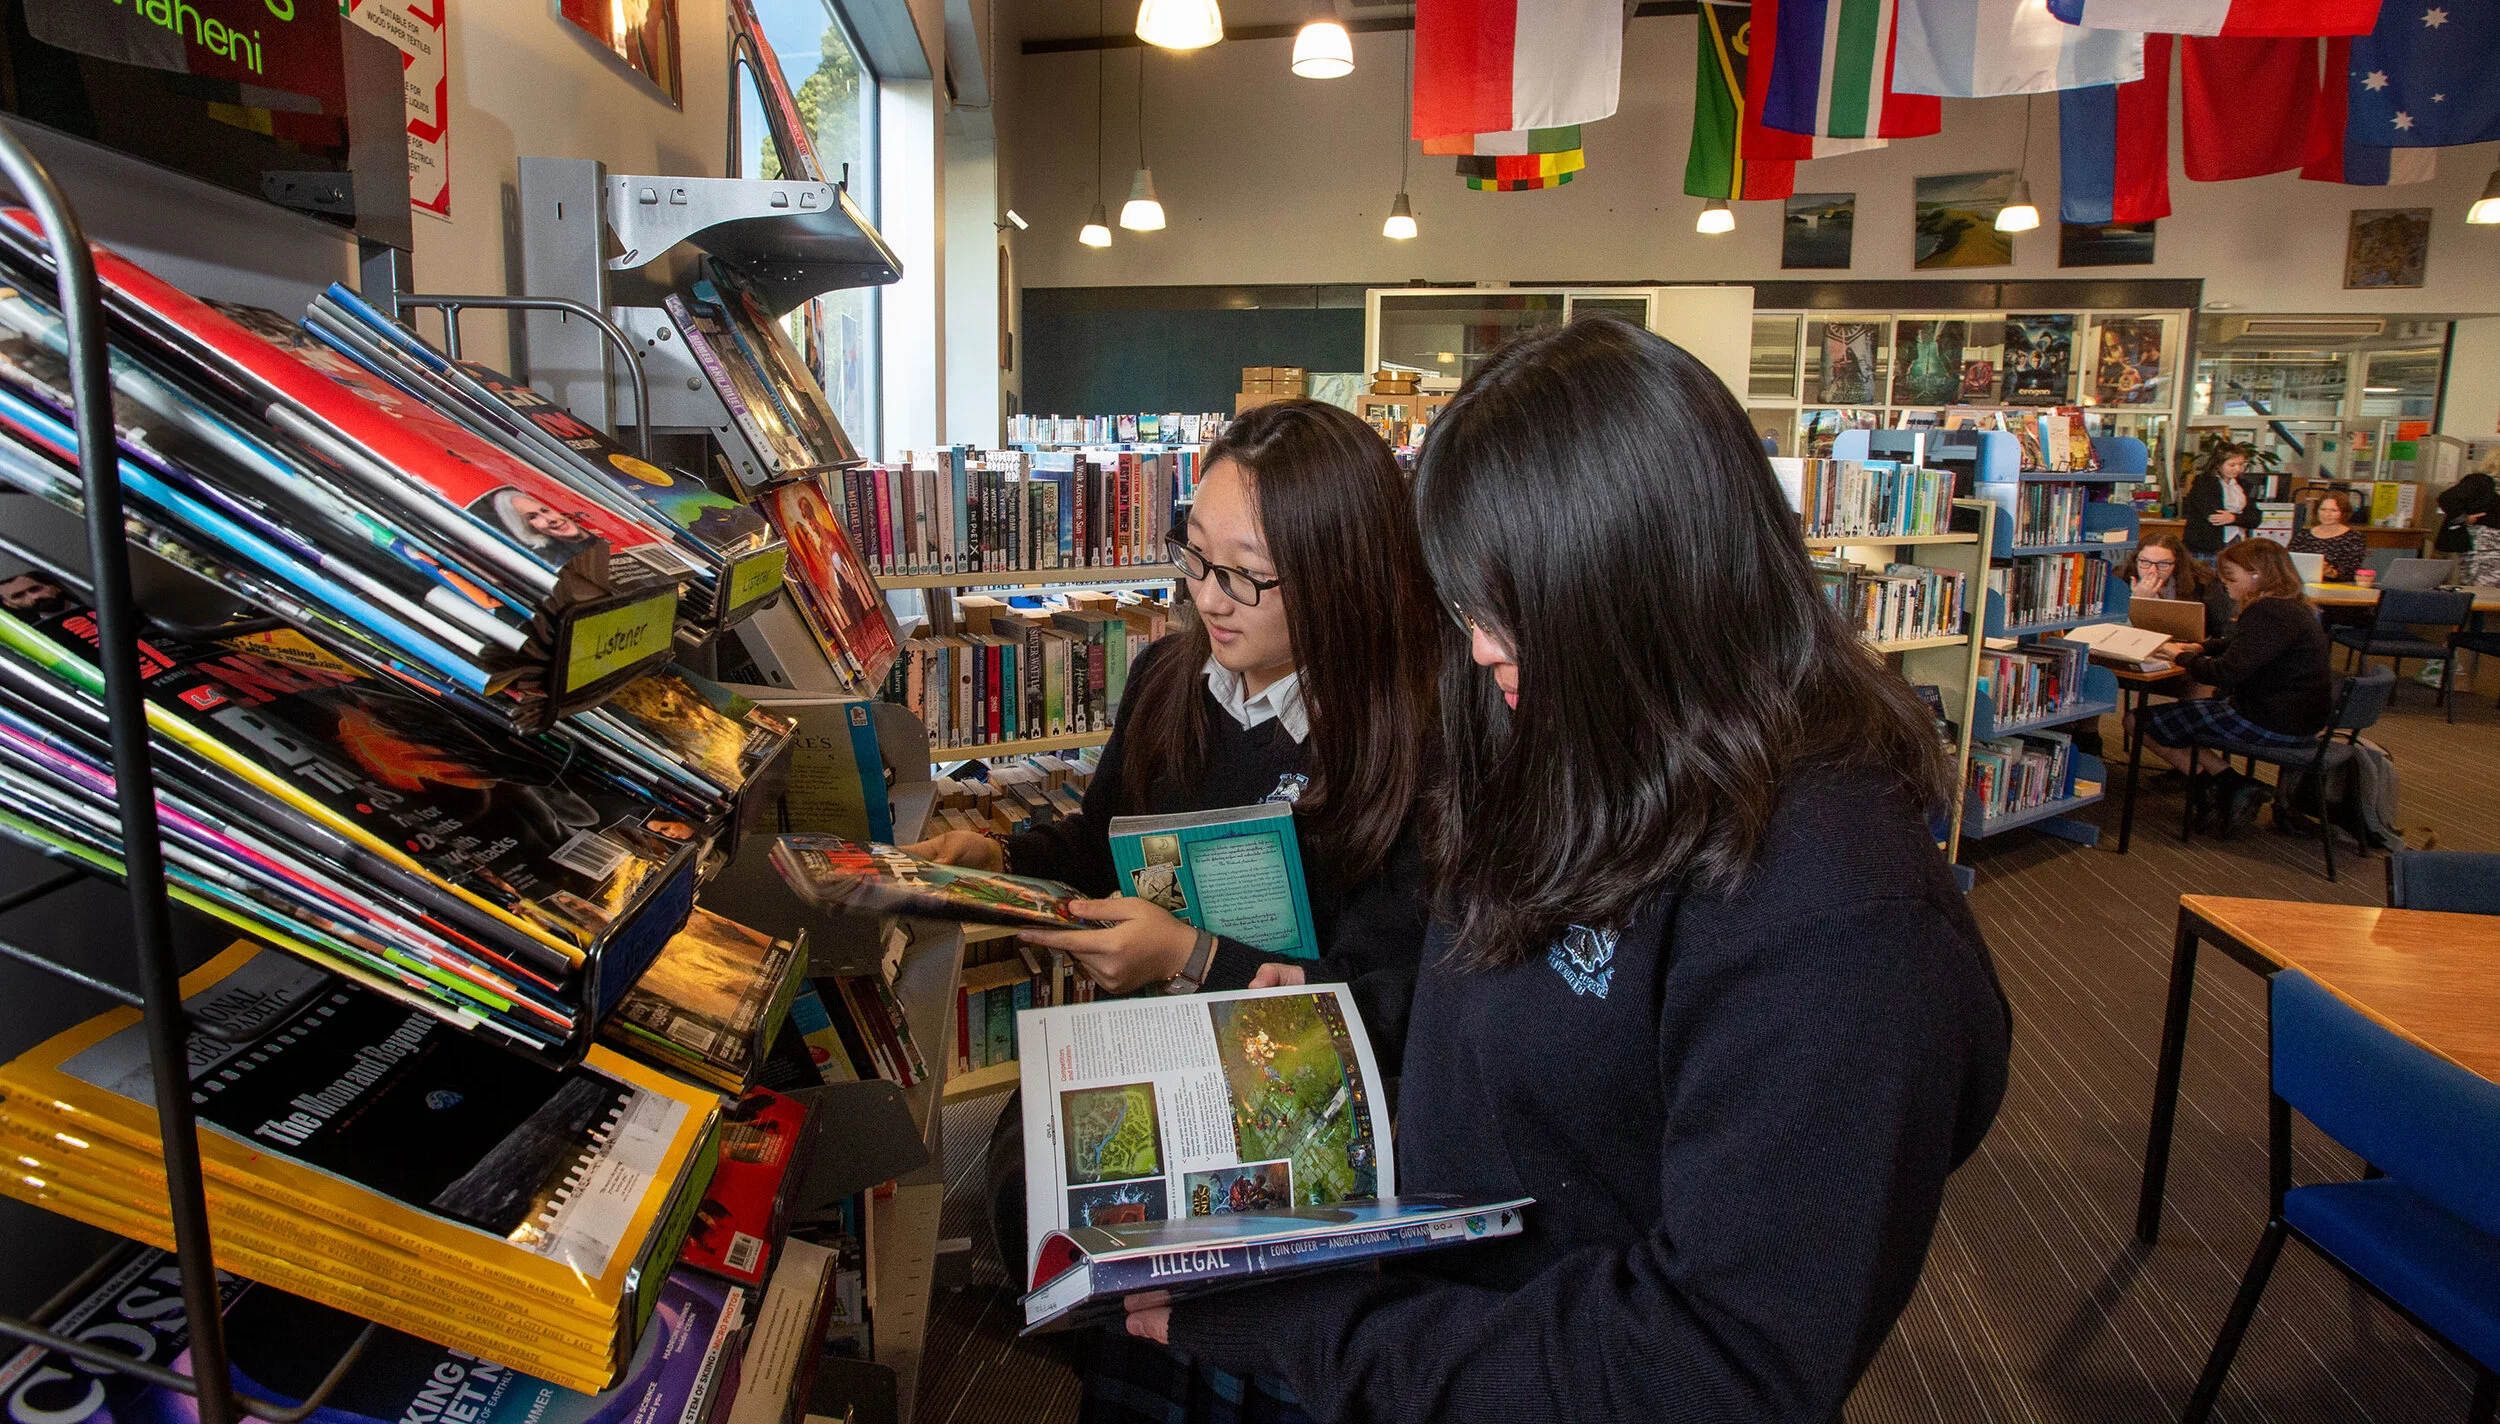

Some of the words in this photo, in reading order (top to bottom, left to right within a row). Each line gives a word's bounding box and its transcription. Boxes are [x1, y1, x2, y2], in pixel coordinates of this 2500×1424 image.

[114, 0, 262, 75] aheni
[367, 10, 387, 29] WOOD
[387, 22, 407, 39] PAPER
[407, 32, 431, 55] TEXTILES
[409, 97, 429, 114] LIQUIDS
[408, 149, 435, 167] LECTRICAL
[1075, 465, 1083, 481] Walk
[1119, 461, 1128, 479] LAST
[981, 487, 989, 521] CARNAGE
[1075, 483, 1083, 506] Across
[1119, 495, 1128, 505] IN
[847, 490, 860, 529] MICHAEL
[1119, 507, 1129, 532] TOWER
[869, 527, 878, 554] MOSQU
[969, 544, 978, 555] X
[742, 568, 772, 593] Listener
[247, 641, 317, 660] top-selling
[594, 622, 648, 660] Listener
[1028, 629, 1039, 655] SILVER
[1030, 657, 1039, 688] WATTLE
[1057, 1047, 1069, 1082] Competitors
[1064, 1044, 1073, 1069] Imitators
[254, 1111, 323, 1147] The
[290, 1078, 365, 1119] Moon
[344, 1052, 391, 1087] and
[1270, 1243, 1289, 1257] EOIN
[1289, 1239, 1318, 1255] COLFER
[1328, 1234, 1360, 1249] ANDREW
[1360, 1230, 1390, 1244] DONKIN
[1398, 1223, 1431, 1239] GIOVANN
[1147, 1247, 1231, 1279] ILLEGAL
[720, 1291, 741, 1324] PHOTOS
[660, 1328, 680, 1360] HADRON
[674, 1330, 689, 1353] Inside
[682, 1311, 697, 1332] CERN
[710, 1323, 729, 1350] MICRO
[697, 1354, 718, 1384] SKIING
[638, 1379, 658, 1412] SCIENCE
[652, 1391, 665, 1407] you
[693, 1383, 706, 1396] OF
[683, 1395, 701, 1421] STEM
